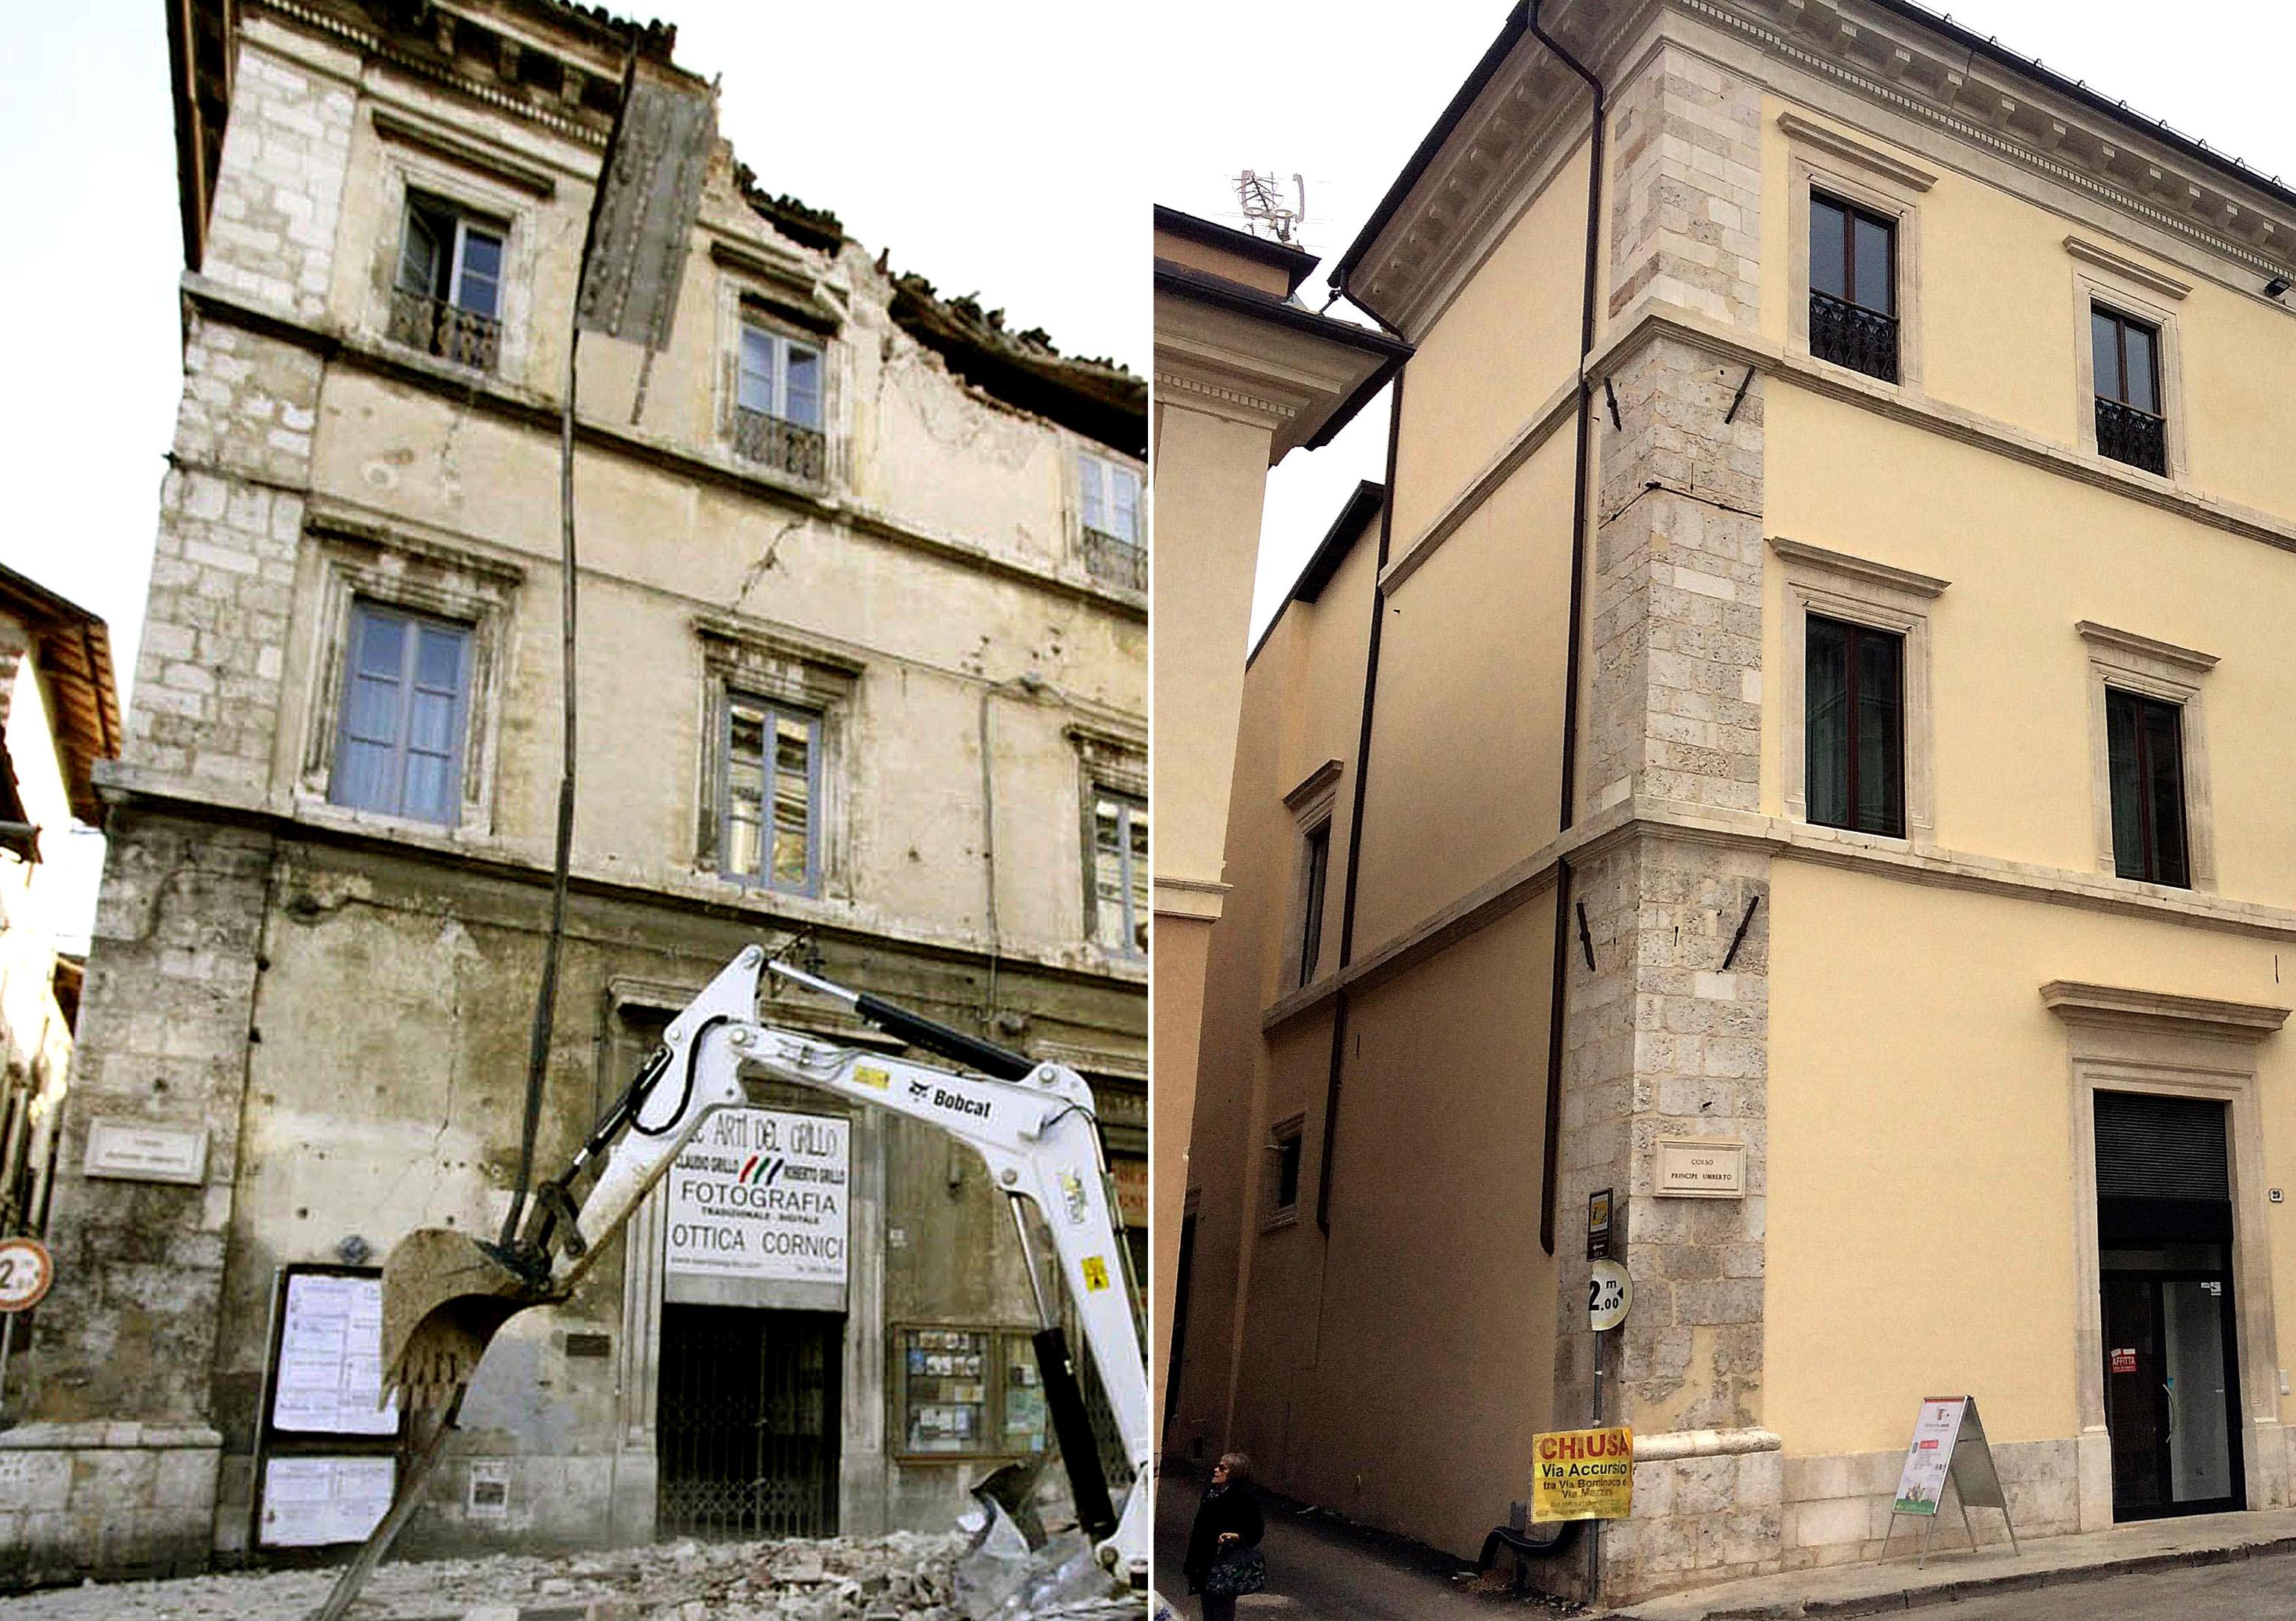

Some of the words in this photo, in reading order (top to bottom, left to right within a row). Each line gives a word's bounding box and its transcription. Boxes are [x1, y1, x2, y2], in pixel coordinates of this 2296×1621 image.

[933, 1088, 991, 1118] Bobcat
[682, 1180, 836, 1214] FOTOGRAFIA
[673, 1224, 746, 1251] OTTICA
[762, 1232, 844, 1259] CORNICI
[2112, 1356, 2135, 1366] AFFITTA
[1540, 1431, 1629, 1460] CHIUSA
[1542, 1463, 1564, 1478] Via
[1569, 1460, 1627, 1477] Accursio
[1543, 1480, 1556, 1489] tra
[1559, 1480, 1574, 1489] Via
[1562, 1489, 1577, 1498] Via
